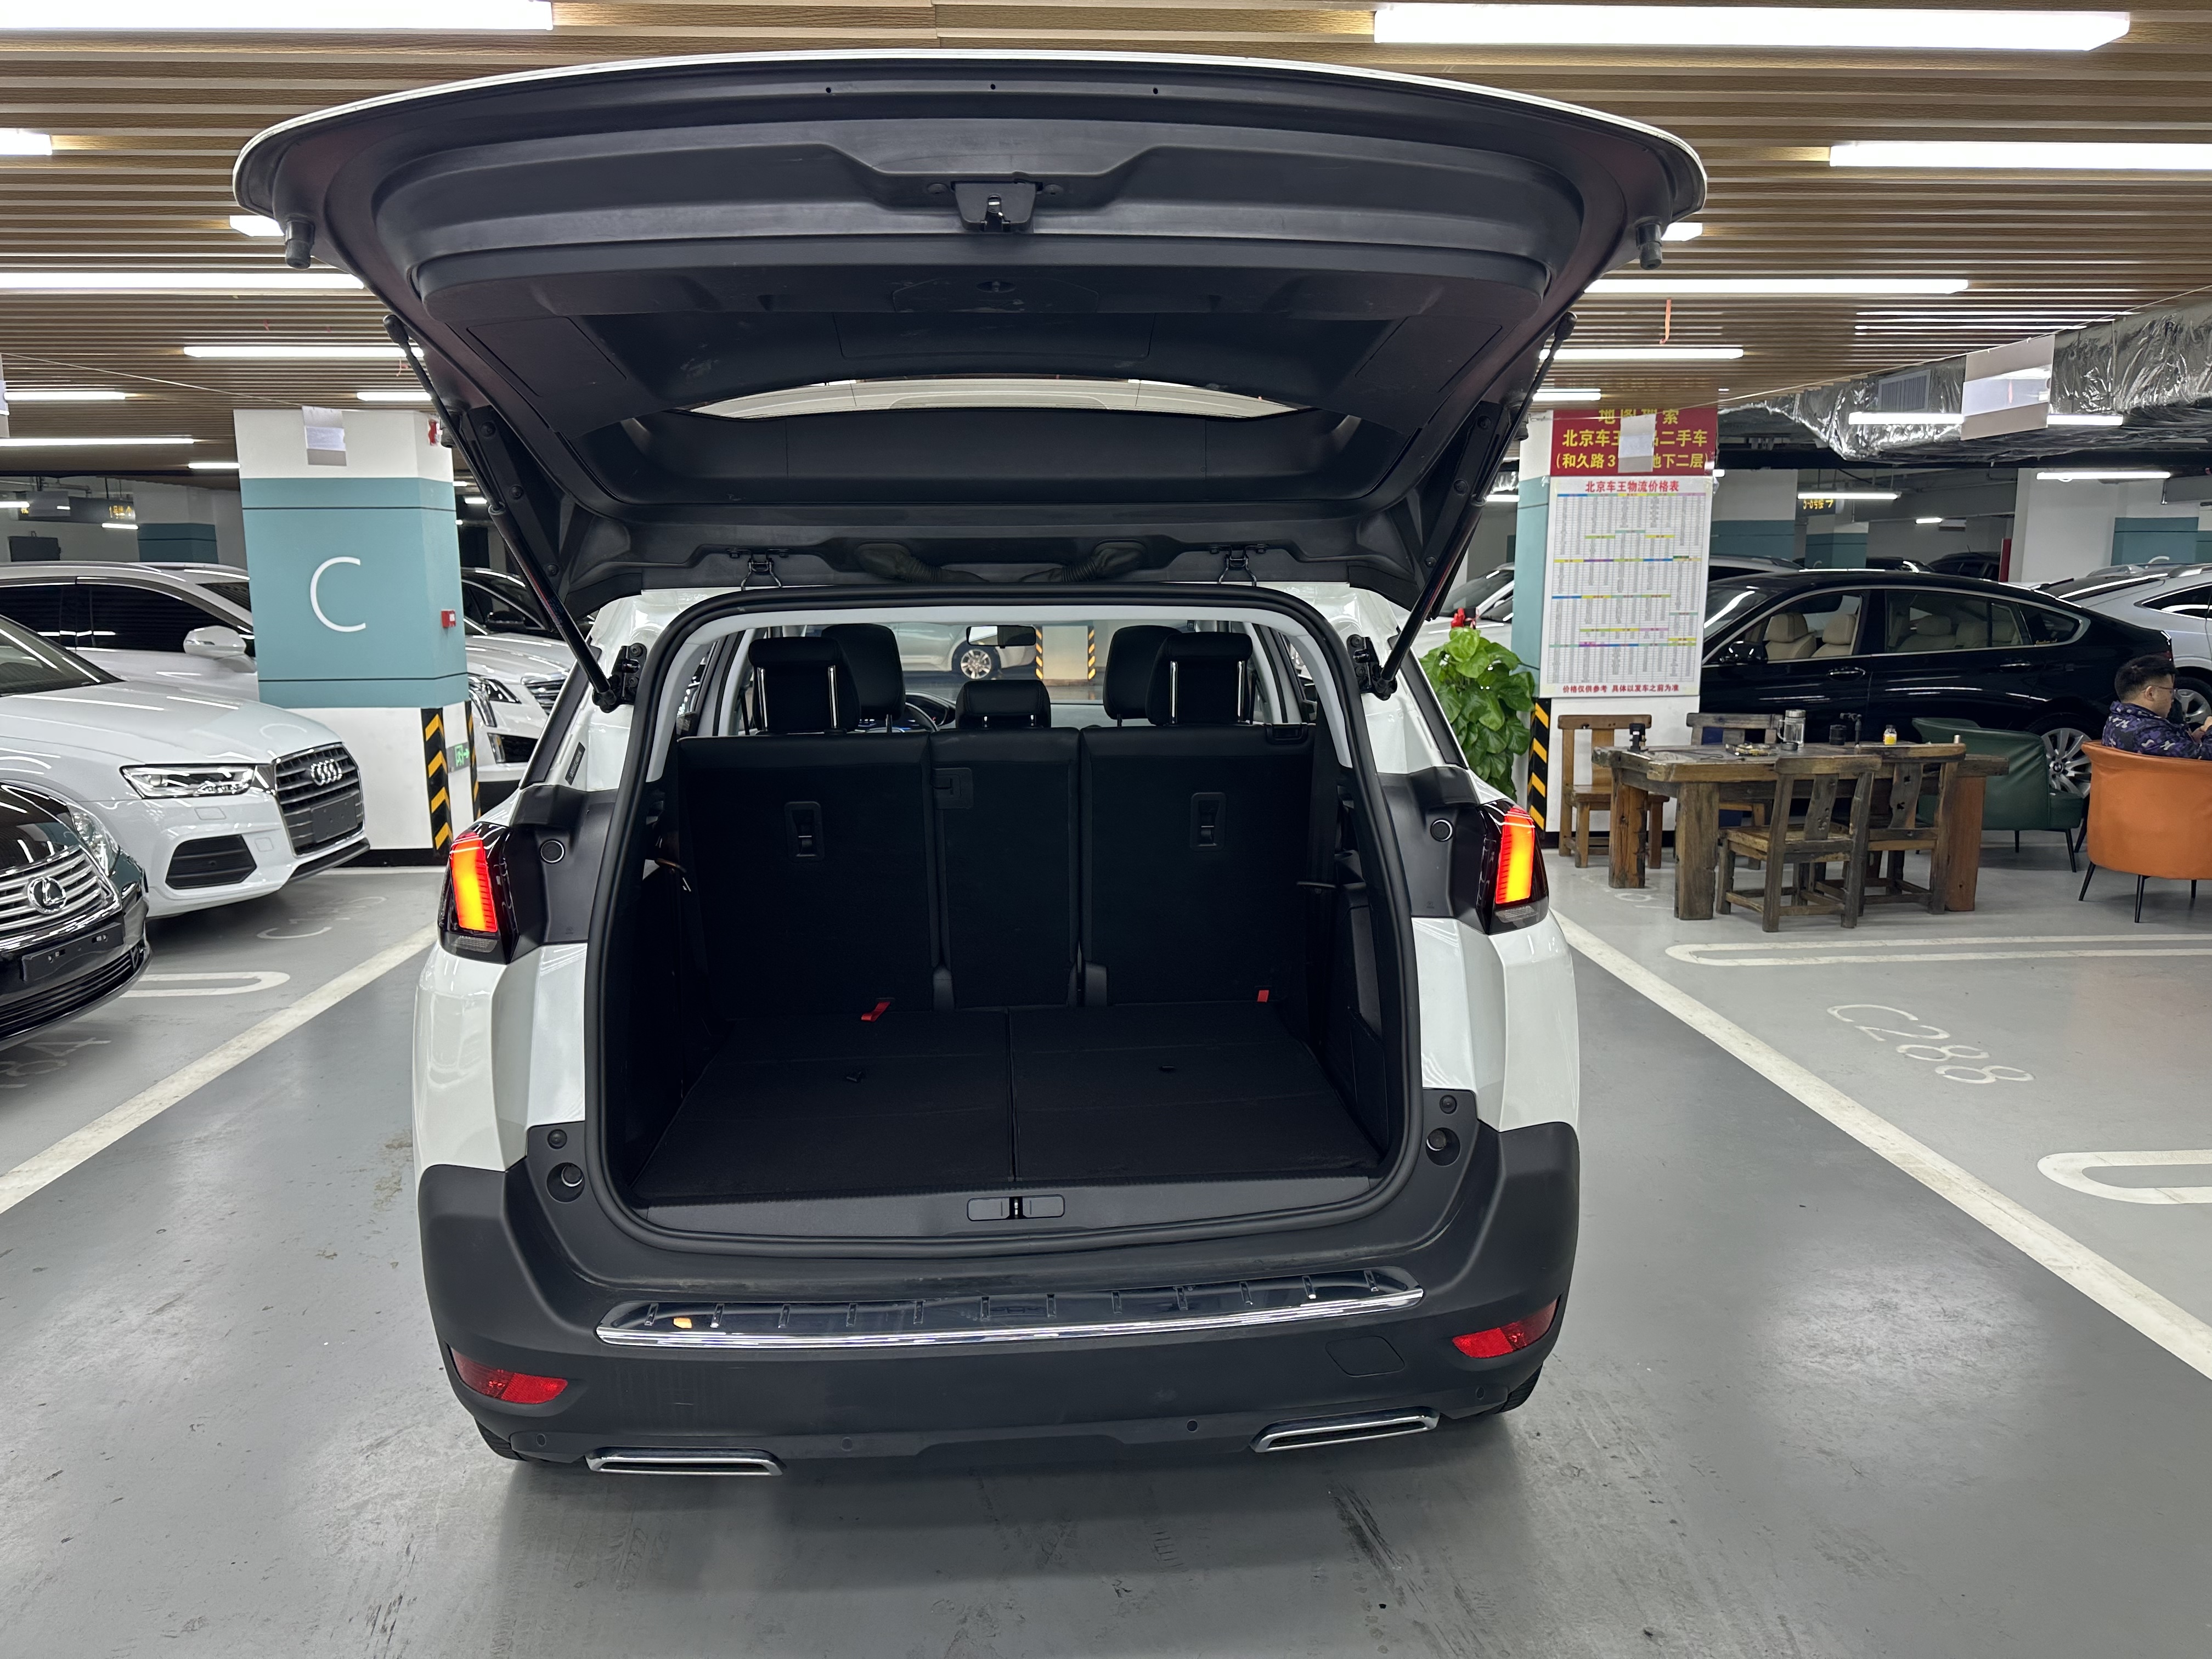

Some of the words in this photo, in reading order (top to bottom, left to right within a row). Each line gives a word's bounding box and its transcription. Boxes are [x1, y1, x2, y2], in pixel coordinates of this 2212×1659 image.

[1562, 430, 1707, 447] 北京车王二手车
[1585, 481, 1679, 492] 北京车王物流价格表
[310, 556, 366, 632] C
[1562, 685, 1607, 693] 价格仅供参考
[1611, 684, 1679, 693] 具体以发车之前为准
[1827, 1005, 2034, 1084] C288
